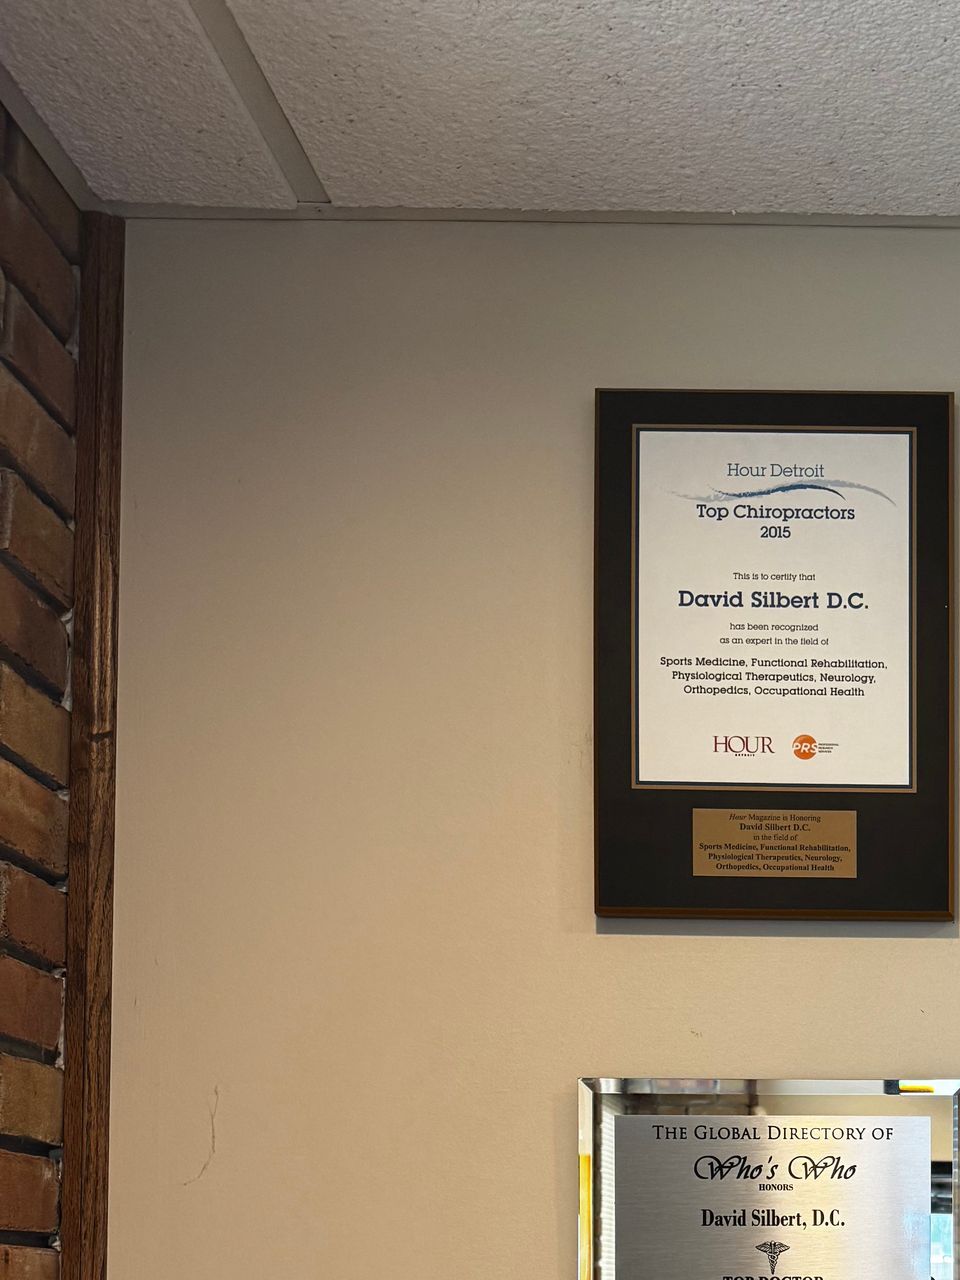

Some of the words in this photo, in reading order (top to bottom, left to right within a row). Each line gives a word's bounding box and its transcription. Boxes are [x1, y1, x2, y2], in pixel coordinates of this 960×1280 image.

[727, 463, 766, 477] Hour
[771, 463, 825, 477] Detroit
[696, 504, 728, 520] Top
[734, 504, 855, 522] Chiropractors
[760, 526, 791, 539] 2015
[761, 572, 768, 580] to
[771, 573, 797, 582] certify
[678, 590, 743, 608] David
[752, 591, 818, 609] Silbert
[827, 591, 869, 609] D.C.
[660, 656, 692, 668] Sports
[696, 656, 747, 667] Medicine,
[752, 657, 807, 667] Functional
[811, 658, 887, 669] Rehabilitation,
[672, 671, 742, 682] Physiological
[746, 671, 816, 683] Therapeutics,
[820, 672, 876, 684] Neurology,
[683, 685, 750, 696] Orthopedics,
[755, 686, 826, 697] Occupational
[831, 687, 864, 695] Health
[713, 735, 775, 753] HOUR
[694, 1155, 778, 1181] Who's
[788, 1155, 856, 1181] Who
[701, 1209, 746, 1228] David
[752, 1209, 806, 1227] Silbert,
[813, 1209, 845, 1228] D.C.
